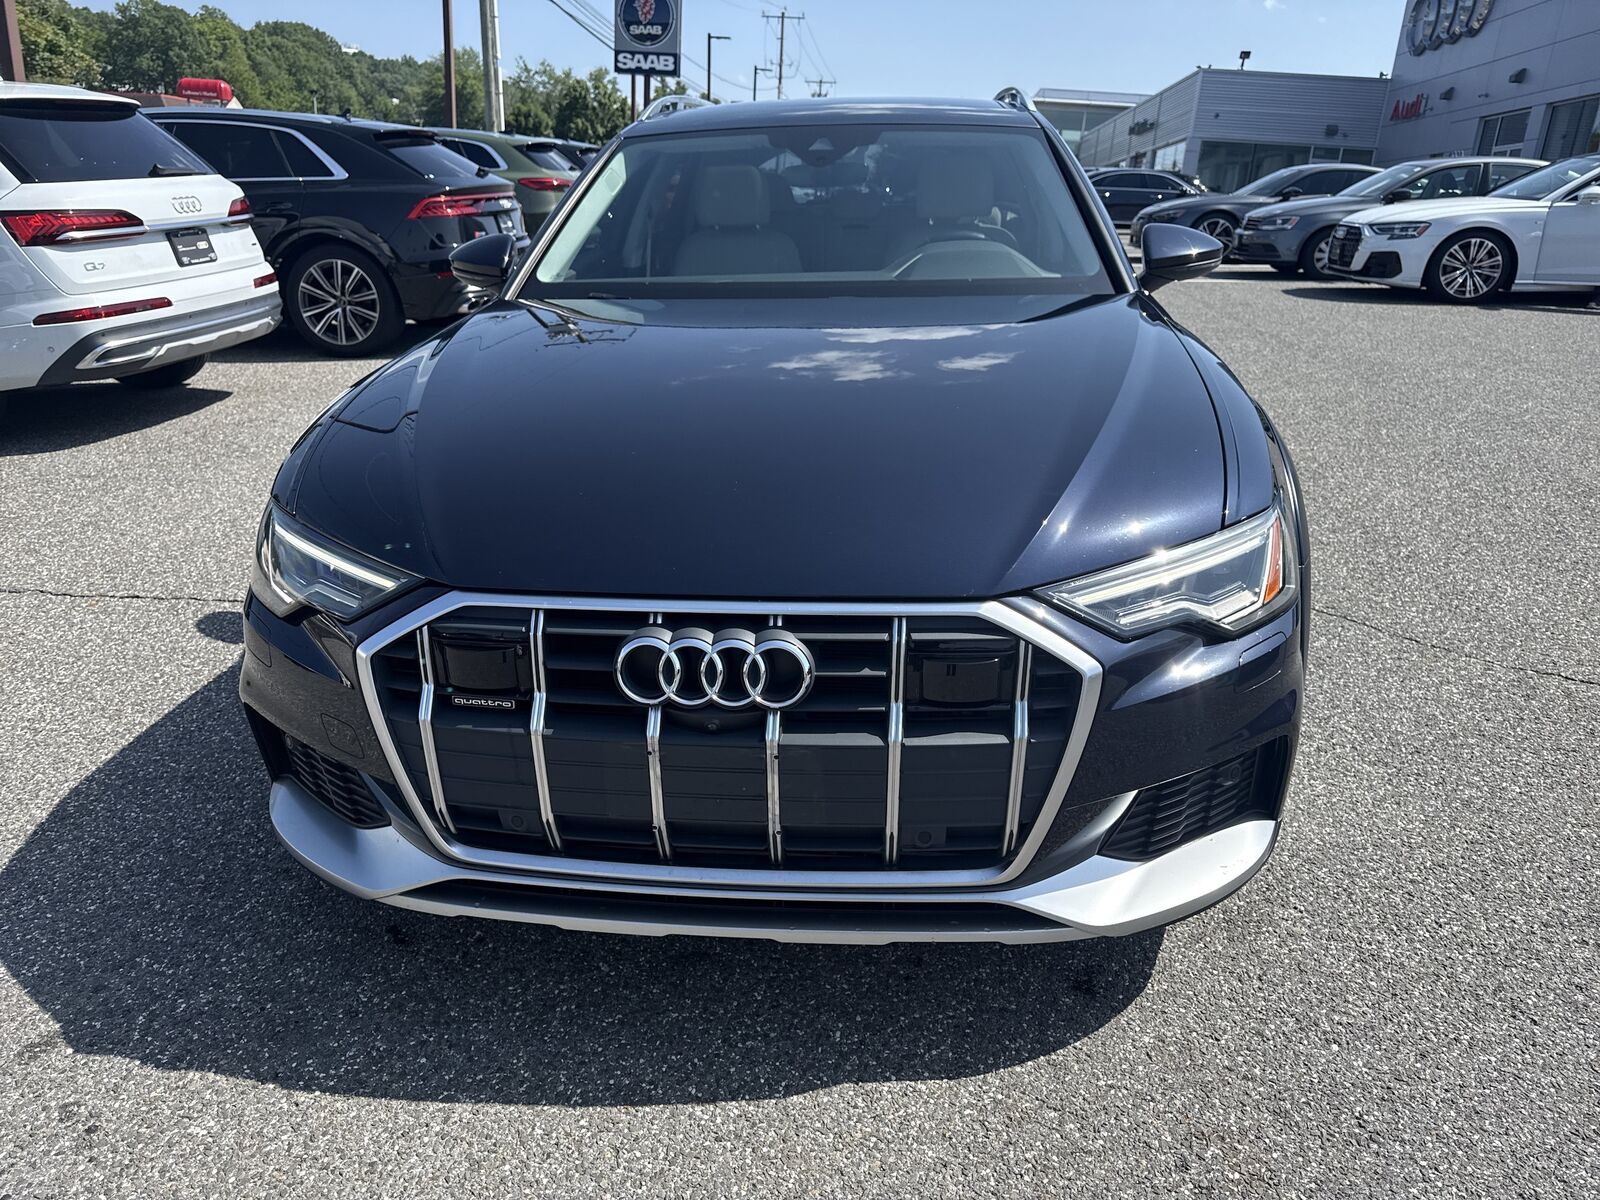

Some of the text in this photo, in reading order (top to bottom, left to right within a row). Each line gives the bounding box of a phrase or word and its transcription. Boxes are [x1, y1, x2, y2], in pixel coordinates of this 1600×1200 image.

[629, 25, 662, 35] SAAB
[616, 52, 675, 71] SAAB
[1390, 93, 1424, 121] Audi
[83, 262, 105, 271] Q7
[454, 698, 512, 707] quattro
